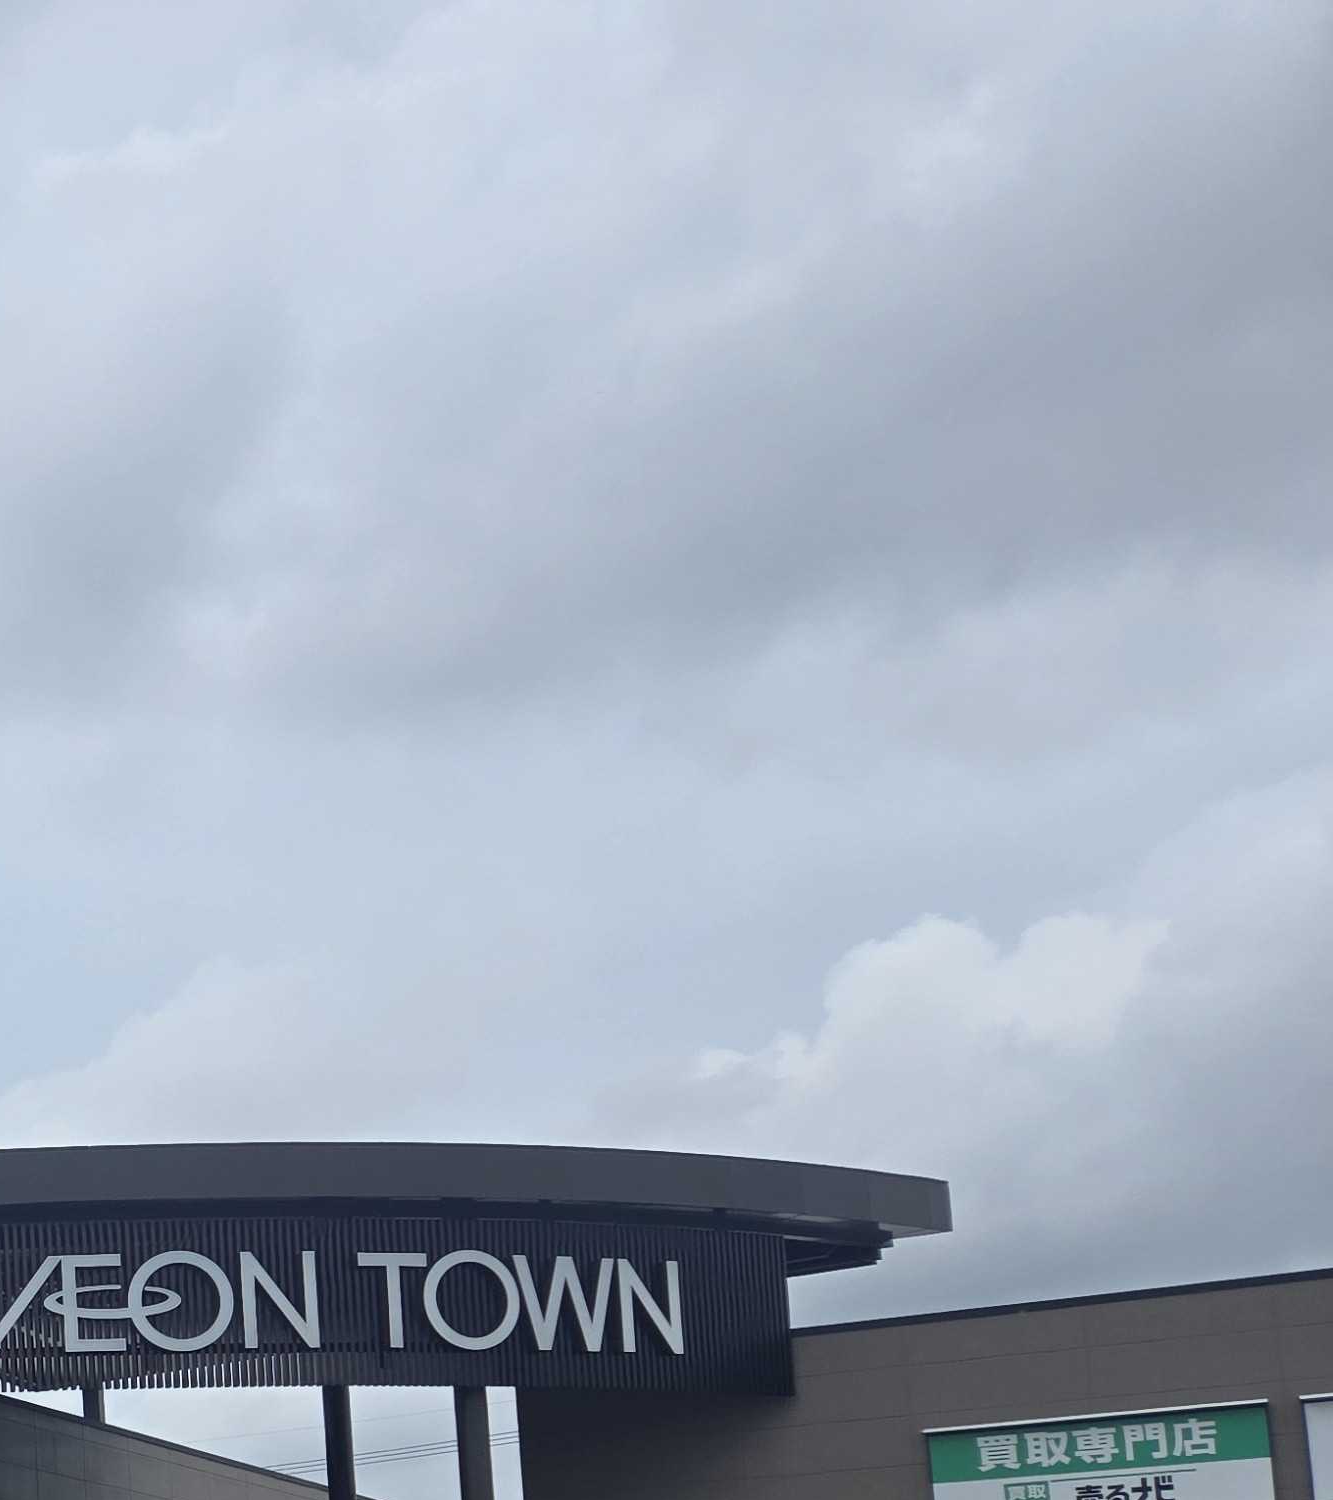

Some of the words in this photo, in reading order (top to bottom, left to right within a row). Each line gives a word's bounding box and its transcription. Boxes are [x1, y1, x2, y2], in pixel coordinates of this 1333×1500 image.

[357, 1248, 685, 1356] TOWN
[975, 1417, 1219, 1473] 買取専門店
[1006, 1484, 1047, 1500] 買取
